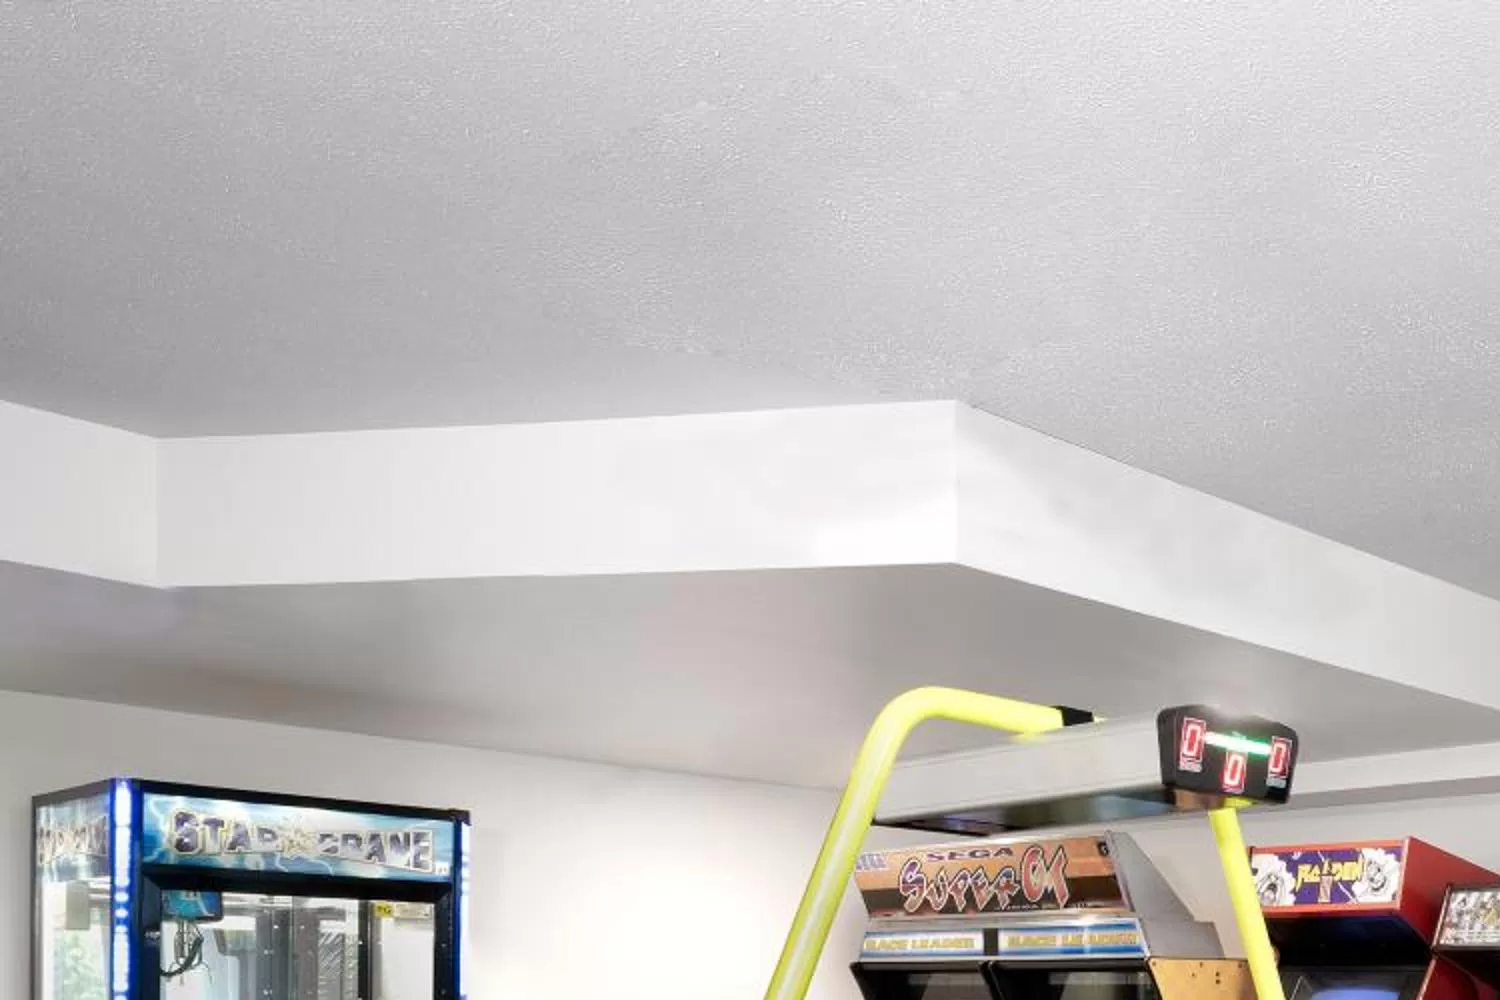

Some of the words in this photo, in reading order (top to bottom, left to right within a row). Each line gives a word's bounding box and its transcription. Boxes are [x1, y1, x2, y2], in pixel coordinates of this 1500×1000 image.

[172, 808, 280, 856] STAR
[317, 828, 435, 873] CRANE
[926, 847, 1014, 862] SEGA
[899, 857, 1020, 913] SUPER
